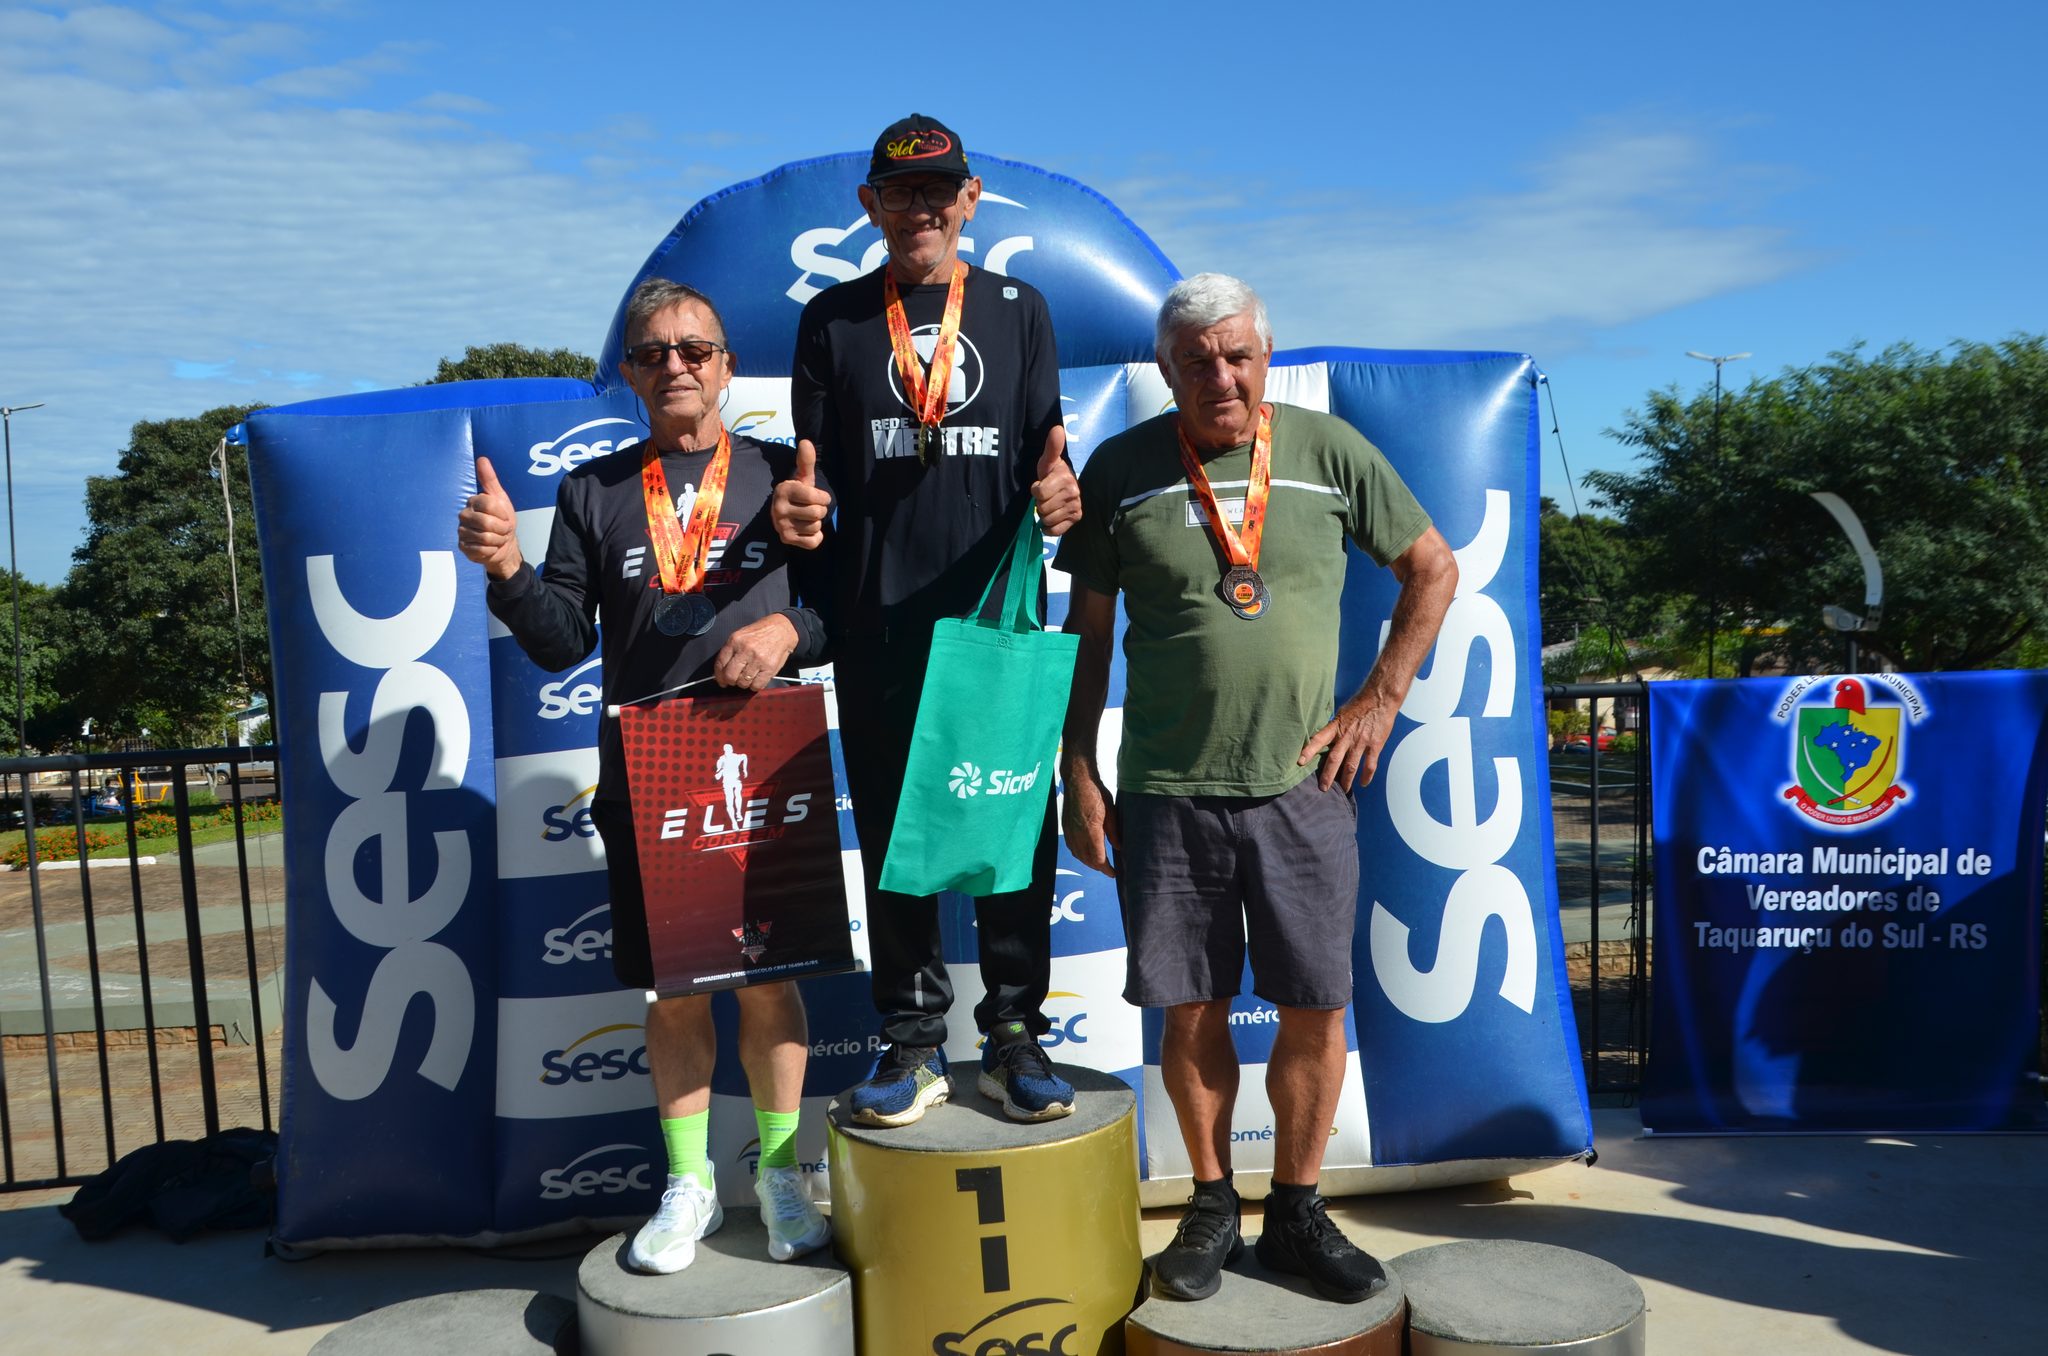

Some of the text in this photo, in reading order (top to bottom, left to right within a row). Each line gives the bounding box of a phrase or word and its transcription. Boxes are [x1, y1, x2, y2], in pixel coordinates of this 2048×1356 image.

[785, 227, 1034, 305] Sc
[871, 417, 910, 431] REDE
[872, 426, 999, 459] METRE
[622, 540, 769, 579] EES
[1777, 683, 1806, 719] PODER
[1807, 807, 1826, 821] PODER
[691, 826, 786, 850] CORREM
[1696, 846, 1992, 881] Câmara Municipal de
[1745, 884, 1941, 912] Vereadores de
[1694, 921, 1832, 954] Taquaruçu
[1840, 922, 1873, 949] do
[1882, 922, 1925, 949] Sul
[1949, 923, 1988, 950] RS
[955, 1165, 1011, 1294] 1
